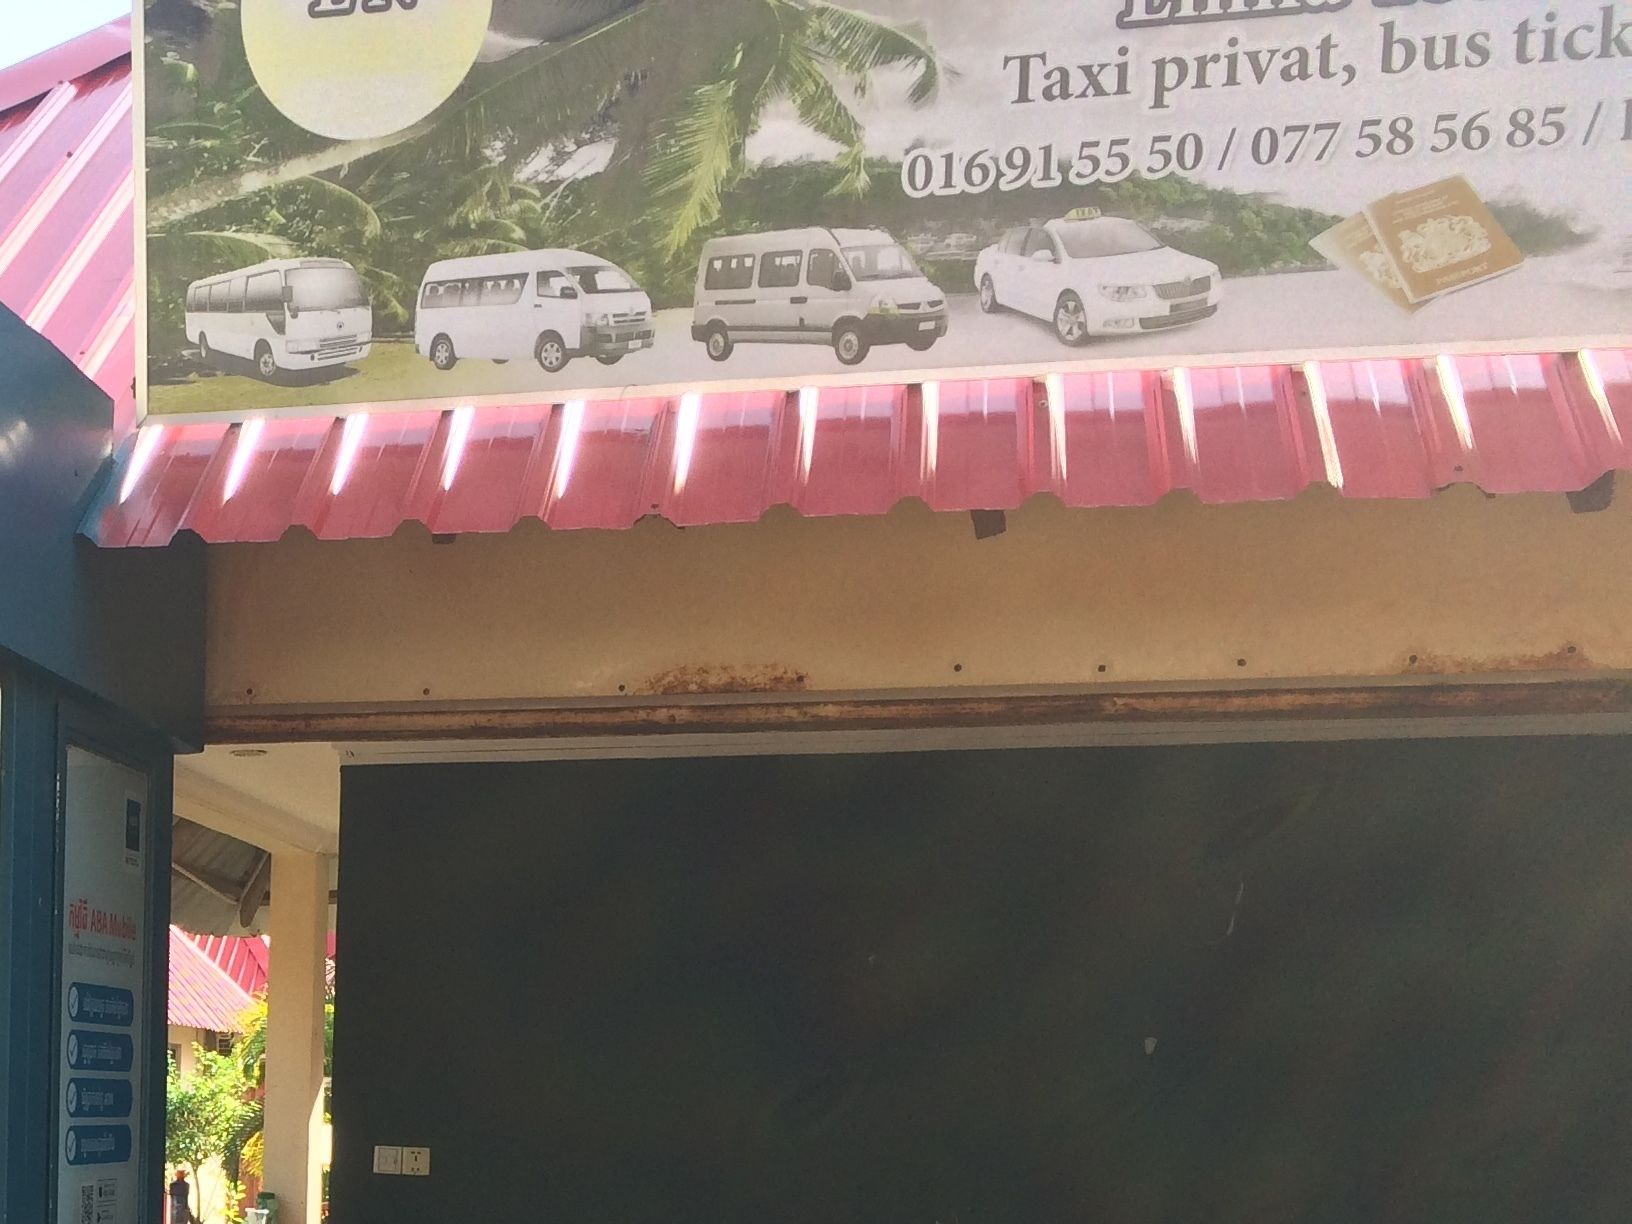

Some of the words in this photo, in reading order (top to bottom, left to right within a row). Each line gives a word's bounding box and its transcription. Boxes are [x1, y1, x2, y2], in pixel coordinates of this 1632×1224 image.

[1002, 45, 1133, 107] Taxi
[1150, 33, 1358, 110] privat,
[1379, 20, 1490, 75] bus
[1074, 137, 1131, 179] 55
[1145, 132, 1204, 175] 50
[1250, 120, 1342, 166] 077
[1354, 116, 1415, 159] 58
[1429, 109, 1492, 154] 56
[1505, 105, 1567, 149] 85
